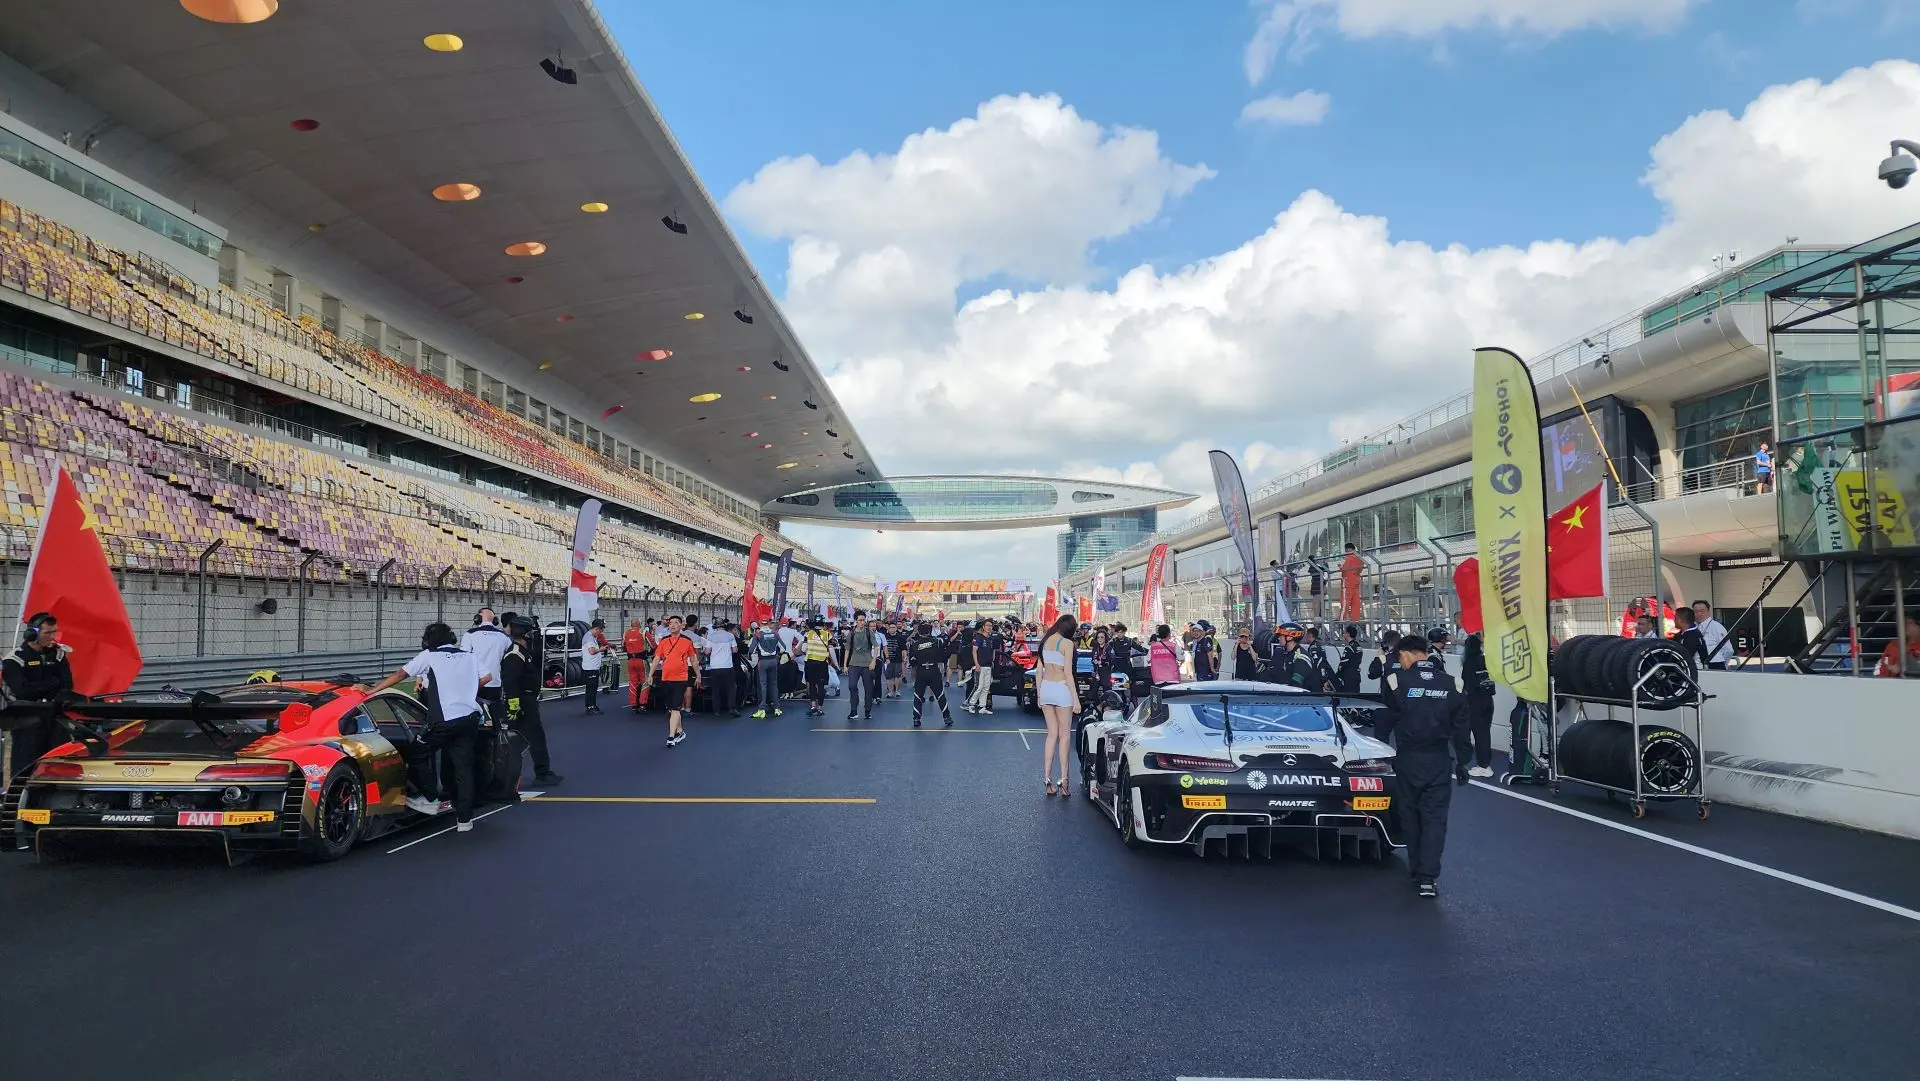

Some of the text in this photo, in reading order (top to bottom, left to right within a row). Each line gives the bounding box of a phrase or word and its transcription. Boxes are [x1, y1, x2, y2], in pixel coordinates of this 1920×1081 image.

[1831, 530, 1842, 550] Pit
[1272, 774, 1342, 787] MANTLE
[1357, 779, 1379, 791] AM
[1185, 796, 1222, 808] PIRELLI
[1268, 799, 1317, 808] FANATEC
[1357, 797, 1388, 809] PIRELLI
[101, 814, 153, 823] FANATEC
[187, 812, 215, 826] AM
